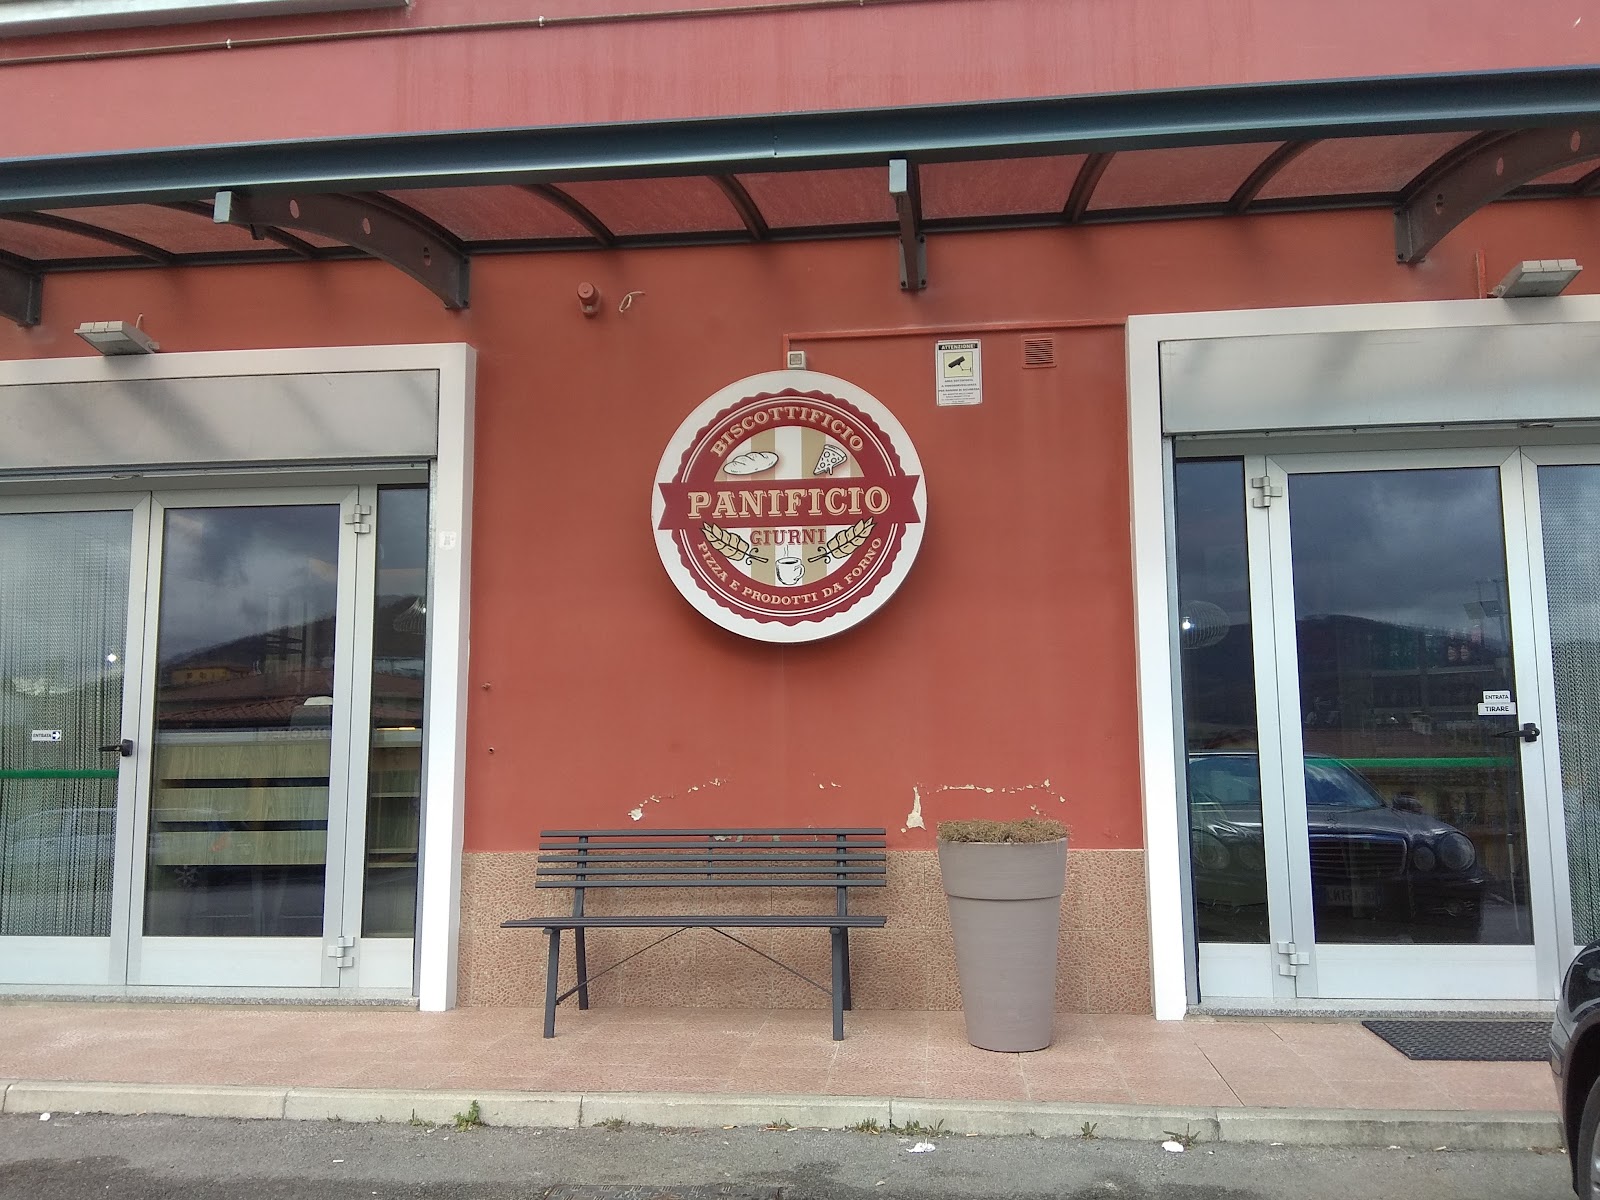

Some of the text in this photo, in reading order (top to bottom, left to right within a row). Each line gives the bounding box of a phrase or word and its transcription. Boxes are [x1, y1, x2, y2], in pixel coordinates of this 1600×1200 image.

[710, 406, 864, 457] BISCOTTIFICIO
[687, 486, 891, 519] PANIFICIO
[750, 528, 827, 546] GIURNI
[697, 538, 882, 605] PIZZA E PRODOTTI DA FORNO
